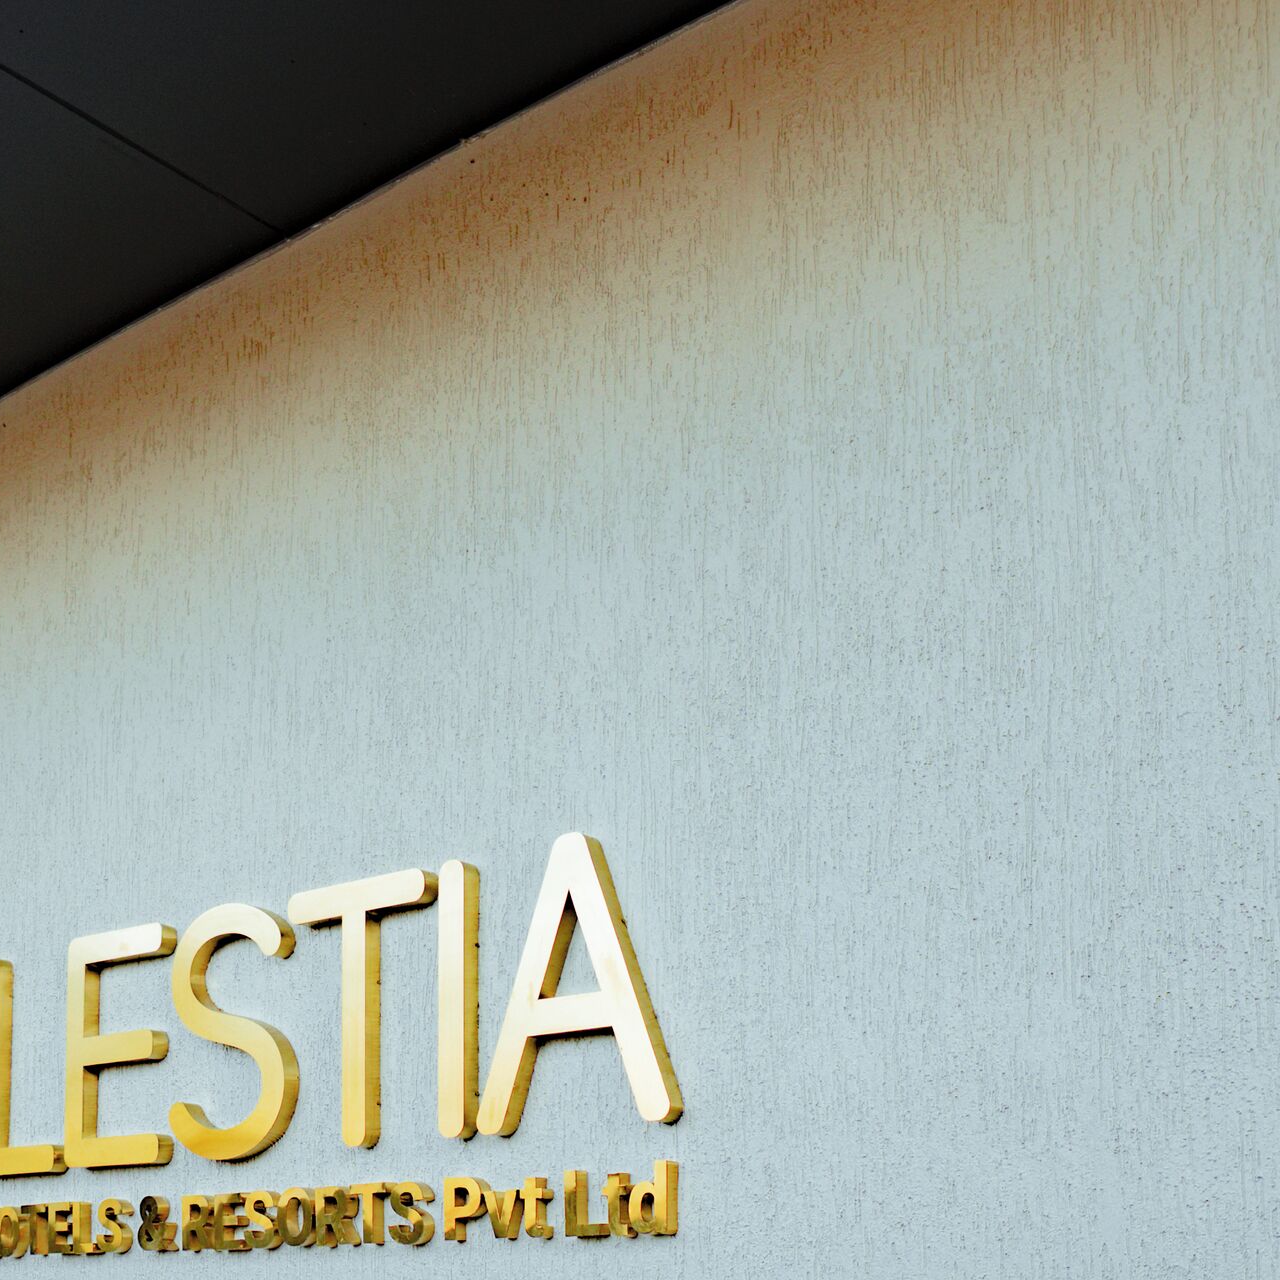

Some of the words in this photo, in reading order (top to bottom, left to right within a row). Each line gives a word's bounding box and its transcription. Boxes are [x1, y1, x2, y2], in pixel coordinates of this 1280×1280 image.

[137, 1196, 179, 1252] &
[181, 1181, 436, 1252] RESORTS
[443, 1176, 554, 1243] Pvt
[564, 1159, 680, 1239] Ltd
